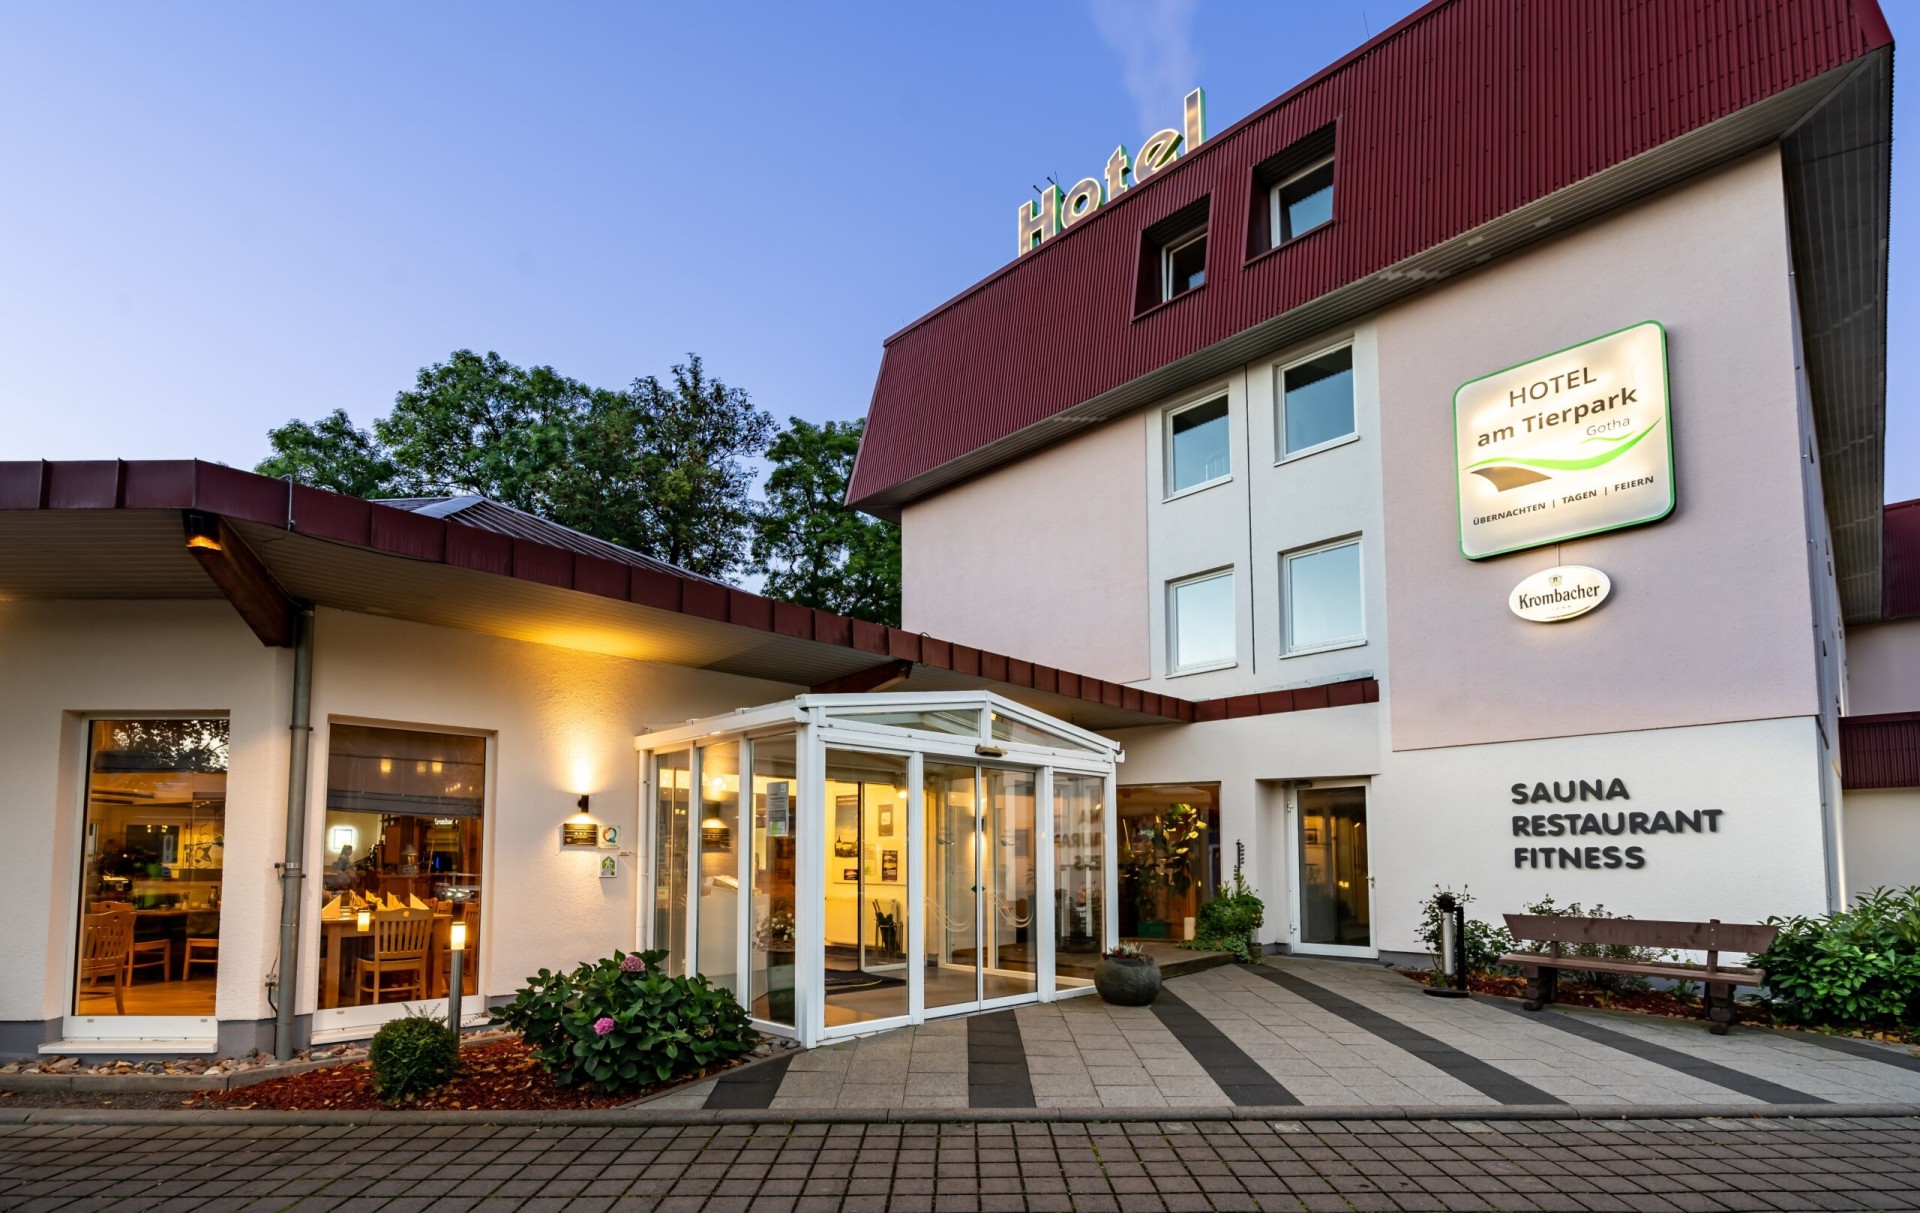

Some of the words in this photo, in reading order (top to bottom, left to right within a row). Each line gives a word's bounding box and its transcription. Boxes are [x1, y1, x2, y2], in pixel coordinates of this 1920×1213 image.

[1018, 86, 1205, 257] Hotel
[1509, 367, 1597, 407] HOTEL
[1477, 425, 1514, 447] am
[1522, 387, 1638, 433] Tierpark
[1586, 417, 1630, 436] Gotha
[1473, 502, 1546, 526] ÜBERNACHTEN
[1562, 489, 1597, 504] TAGEN
[1614, 476, 1654, 492] FEIERN
[1519, 584, 1600, 610] Krombacher
[1511, 778, 1630, 805] SAUNA
[1512, 809, 1723, 837] RESTAURANT
[1514, 846, 1645, 870] FITNESS
